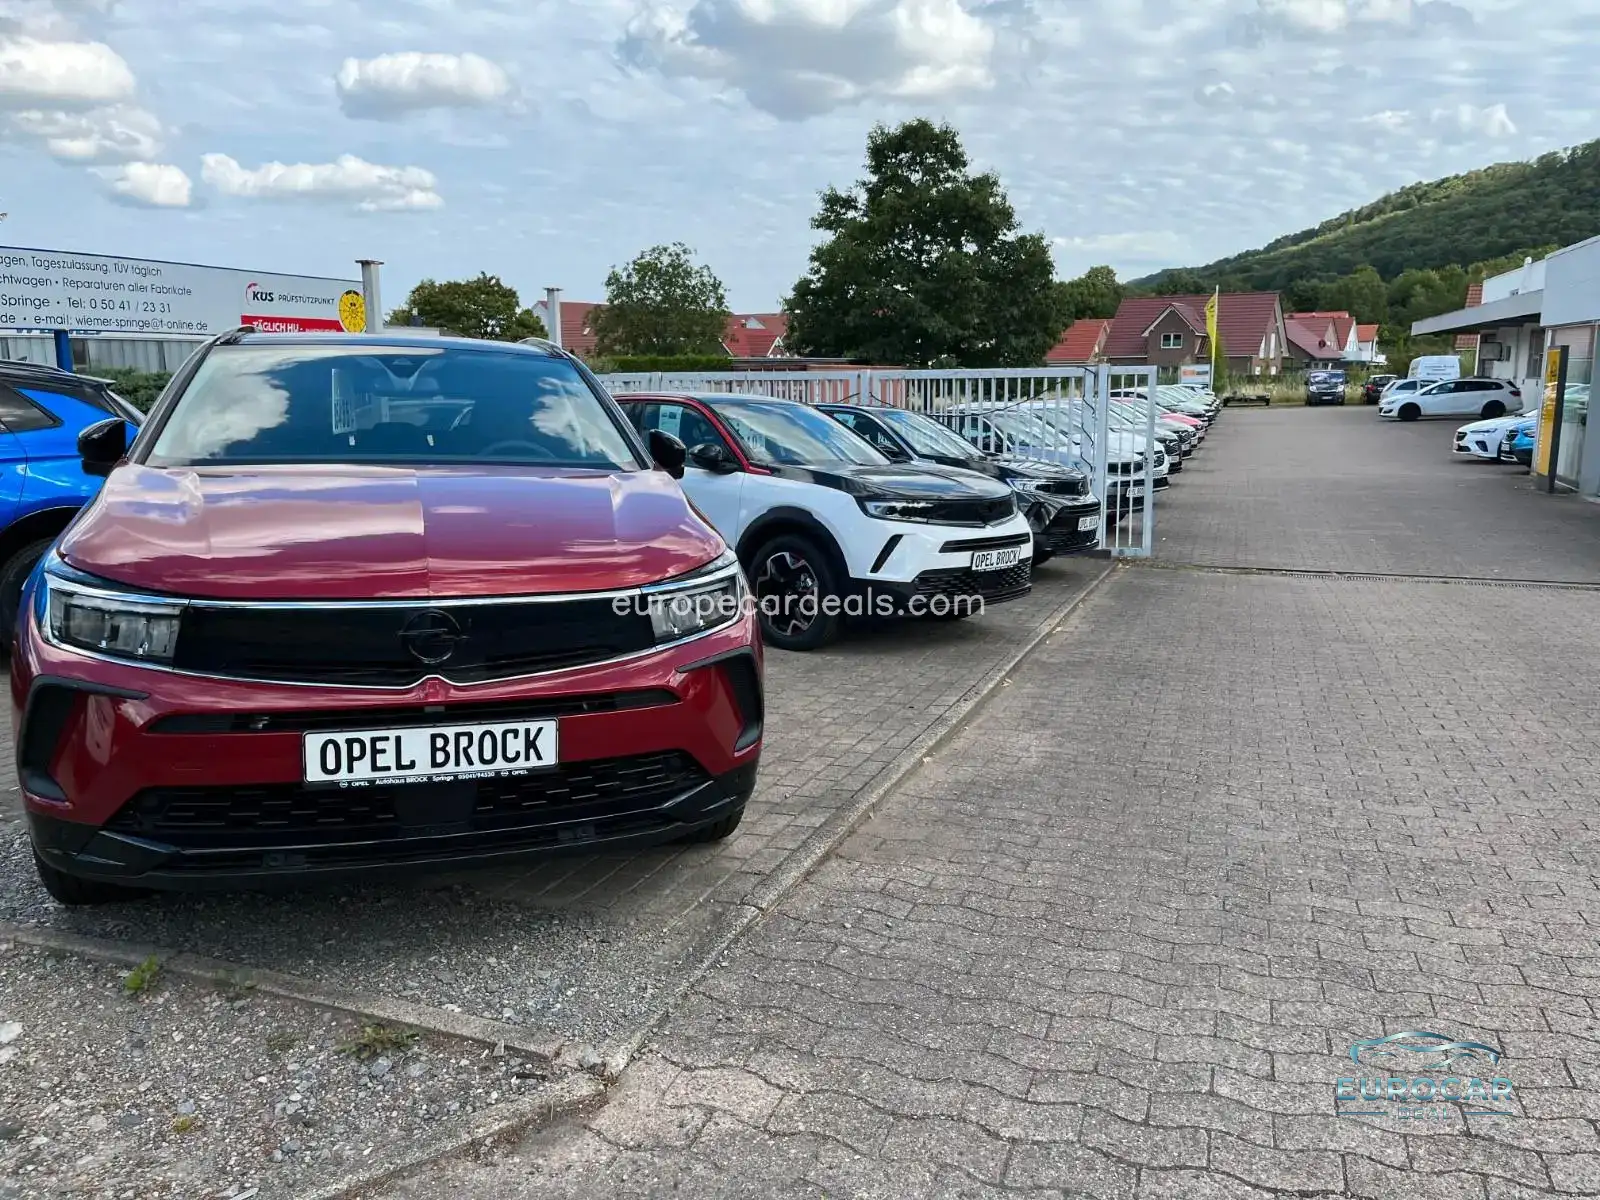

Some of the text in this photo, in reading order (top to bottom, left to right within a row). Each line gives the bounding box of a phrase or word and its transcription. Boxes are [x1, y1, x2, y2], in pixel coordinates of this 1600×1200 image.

[31, 256, 111, 275] Tageszulassung,
[62, 277, 126, 291] Reparaturen
[127, 282, 148, 293] aller
[150, 283, 192, 296] Fabrikate
[1, 294, 50, 309] Springe
[974, 549, 1018, 568] OPEL BROCK
[319, 726, 544, 775] OPEL BROCK
[375, 777, 405, 785] Autohaus
[432, 774, 454, 782] Springe
